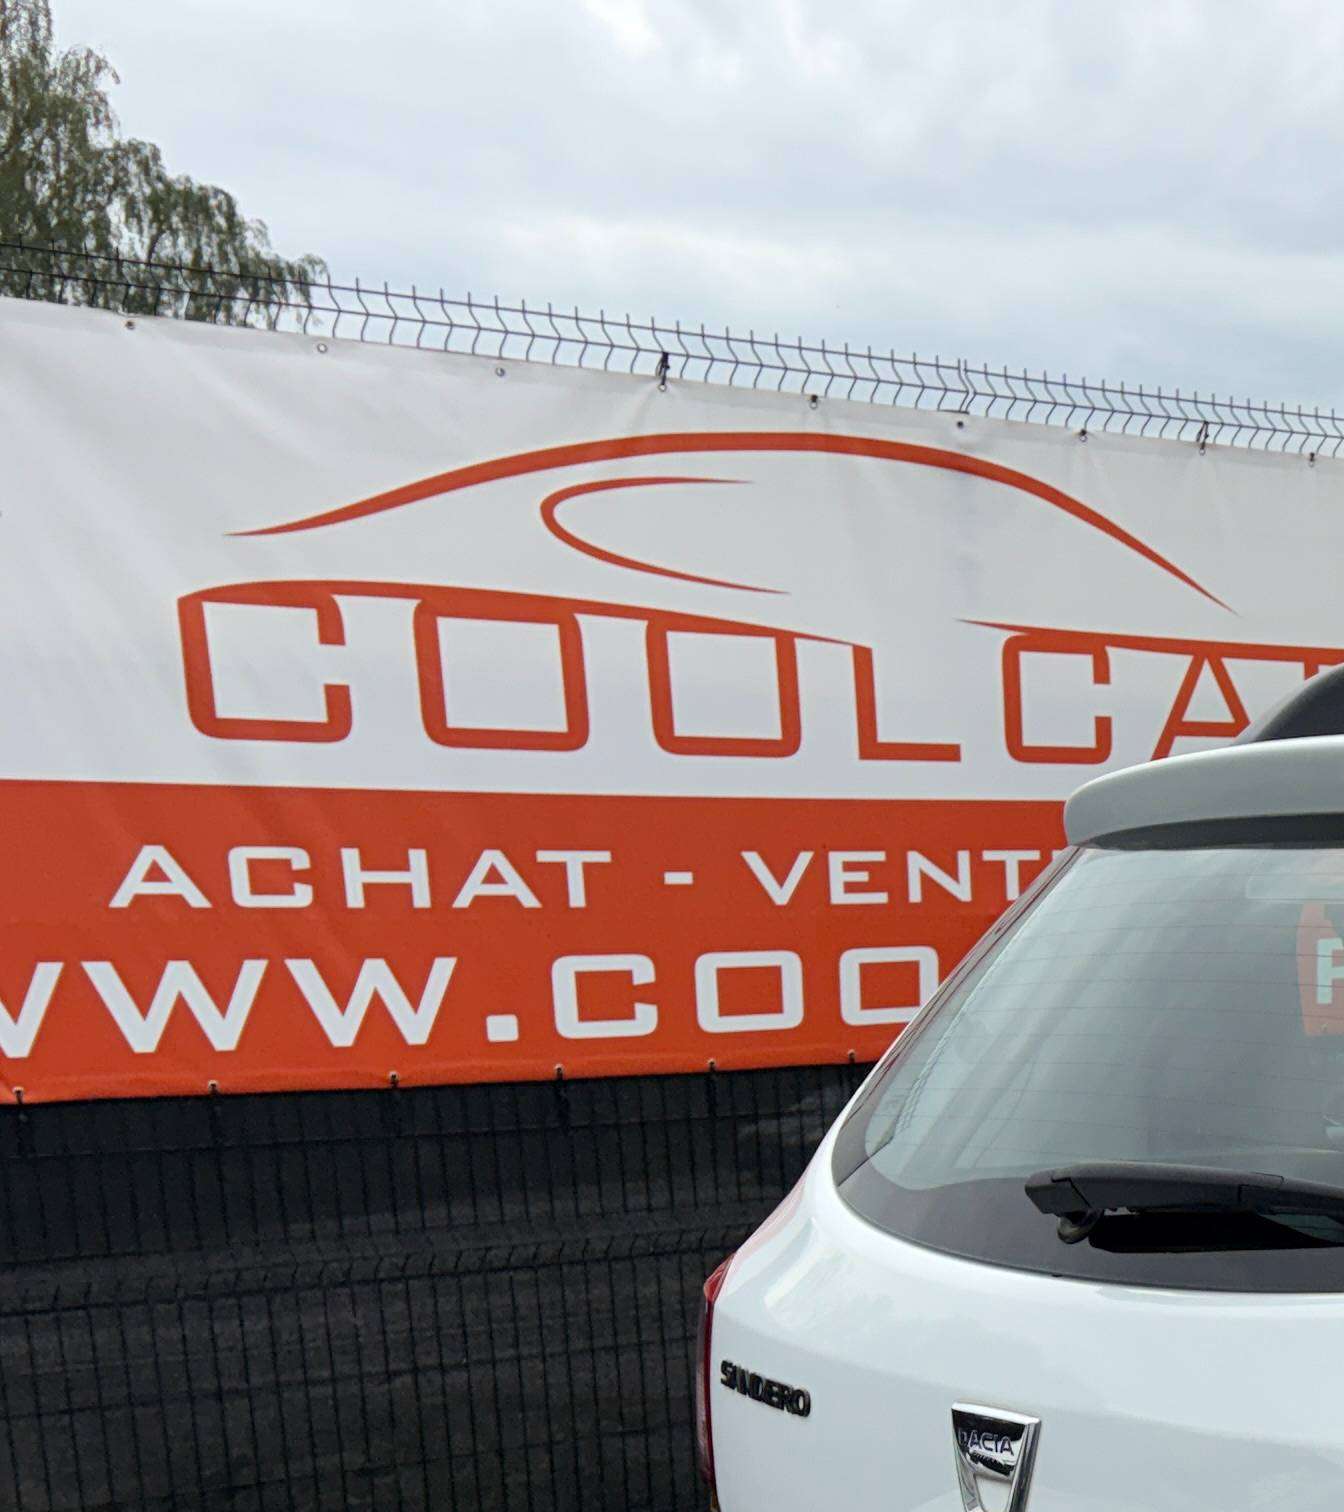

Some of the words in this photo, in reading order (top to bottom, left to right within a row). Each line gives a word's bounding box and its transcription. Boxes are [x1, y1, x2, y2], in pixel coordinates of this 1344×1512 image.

[109, 845, 611, 908] ACHAT
[740, 849, 1068, 906] VENT
[720, 1359, 811, 1418] SANDERO
[958, 1429, 1015, 1457] DACIA
